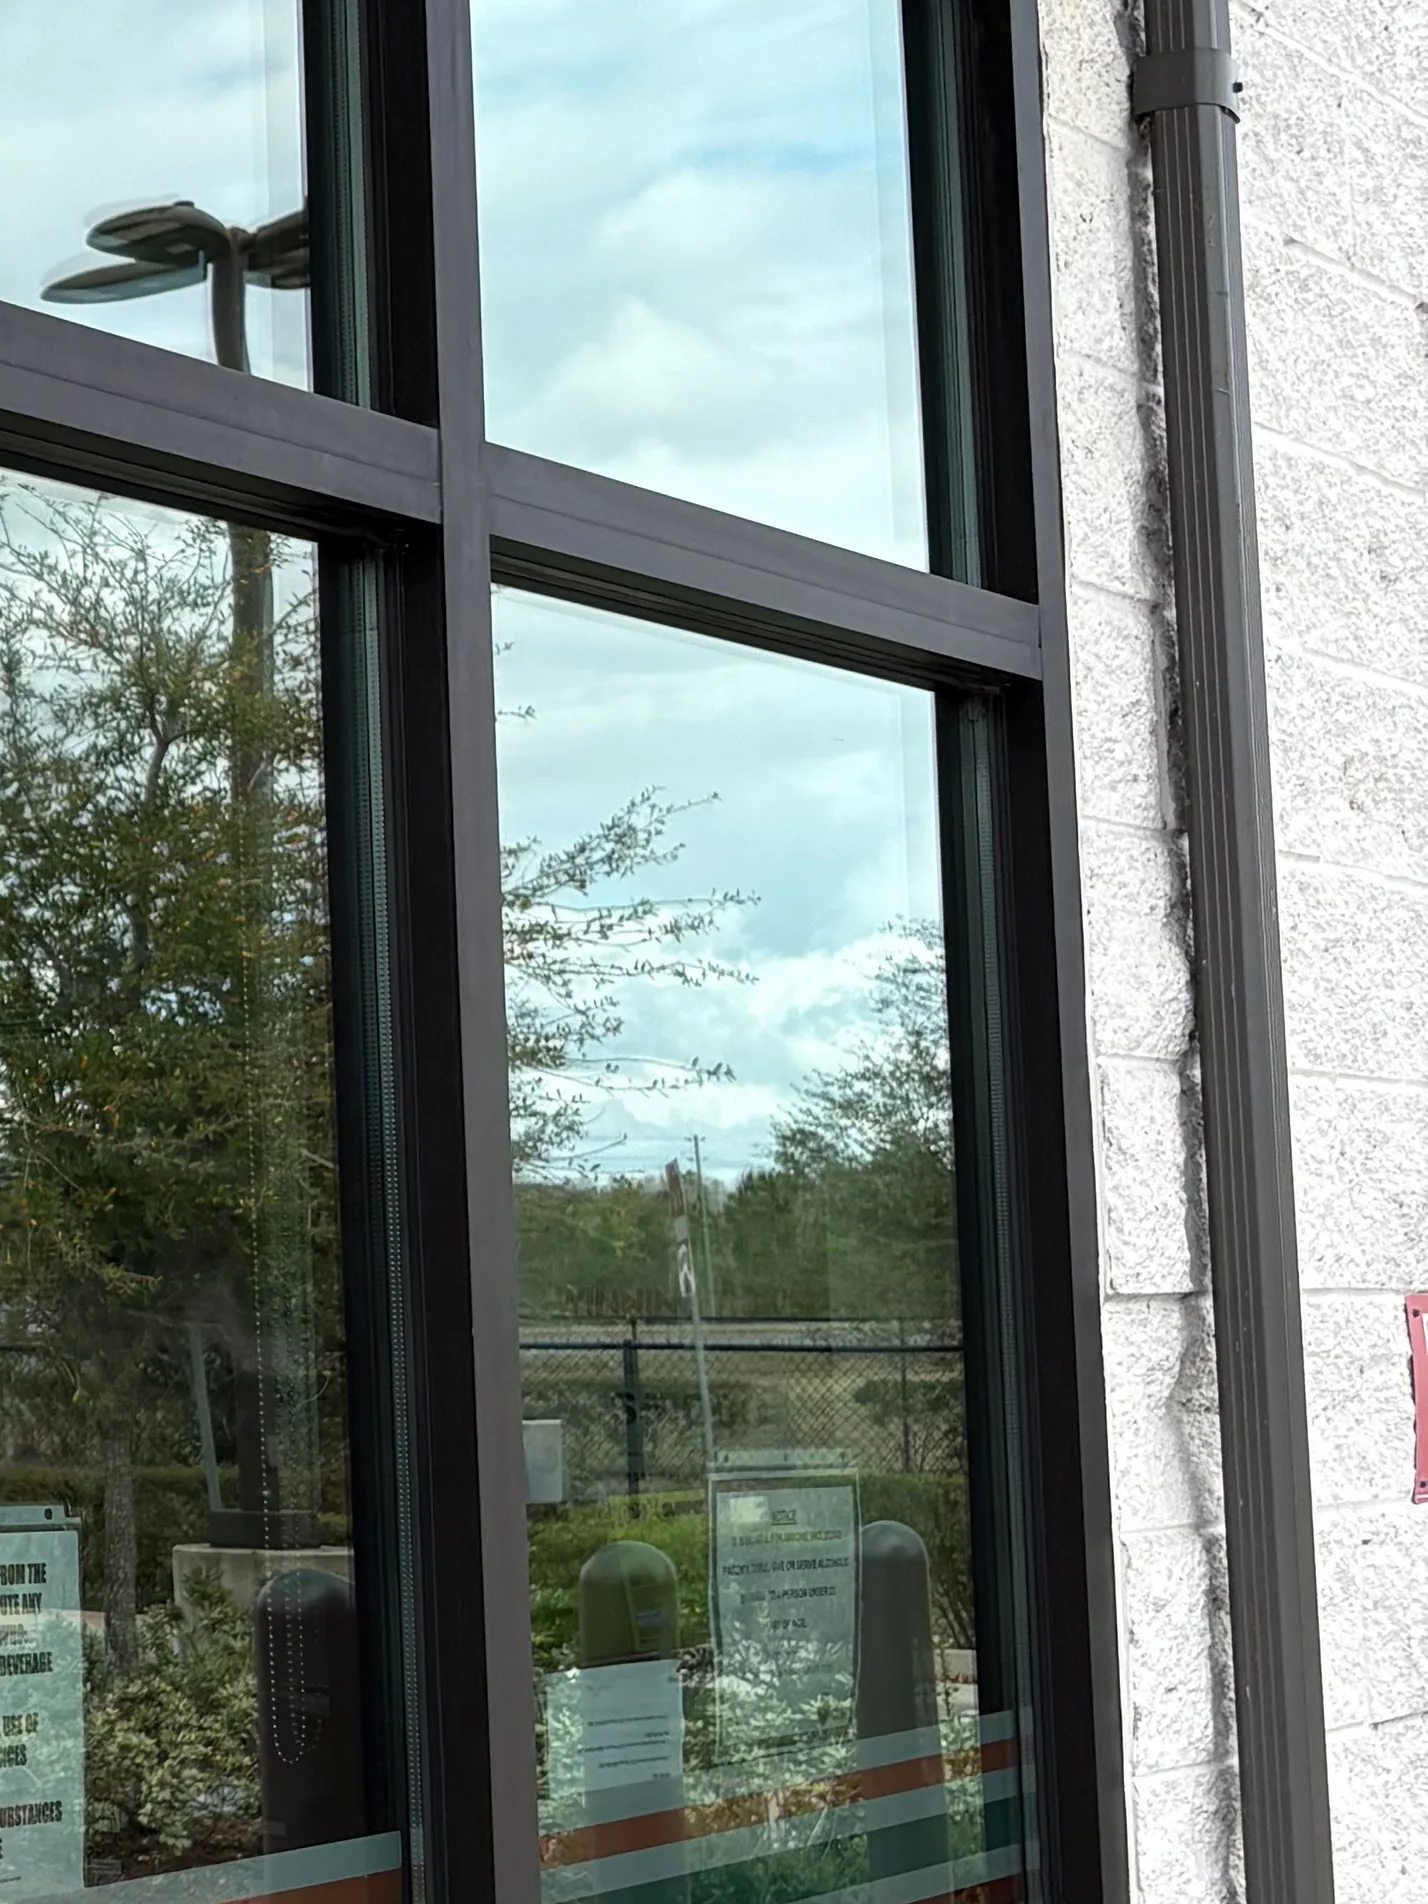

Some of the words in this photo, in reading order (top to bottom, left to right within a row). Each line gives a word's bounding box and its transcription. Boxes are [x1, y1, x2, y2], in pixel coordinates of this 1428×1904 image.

[27, 1561, 47, 1584] THE
[21, 1592, 42, 1615] ANY
[0, 1651, 54, 1677] BEVERAGE
[2, 1714, 24, 1737] USE
[24, 1712, 40, 1734] OF
